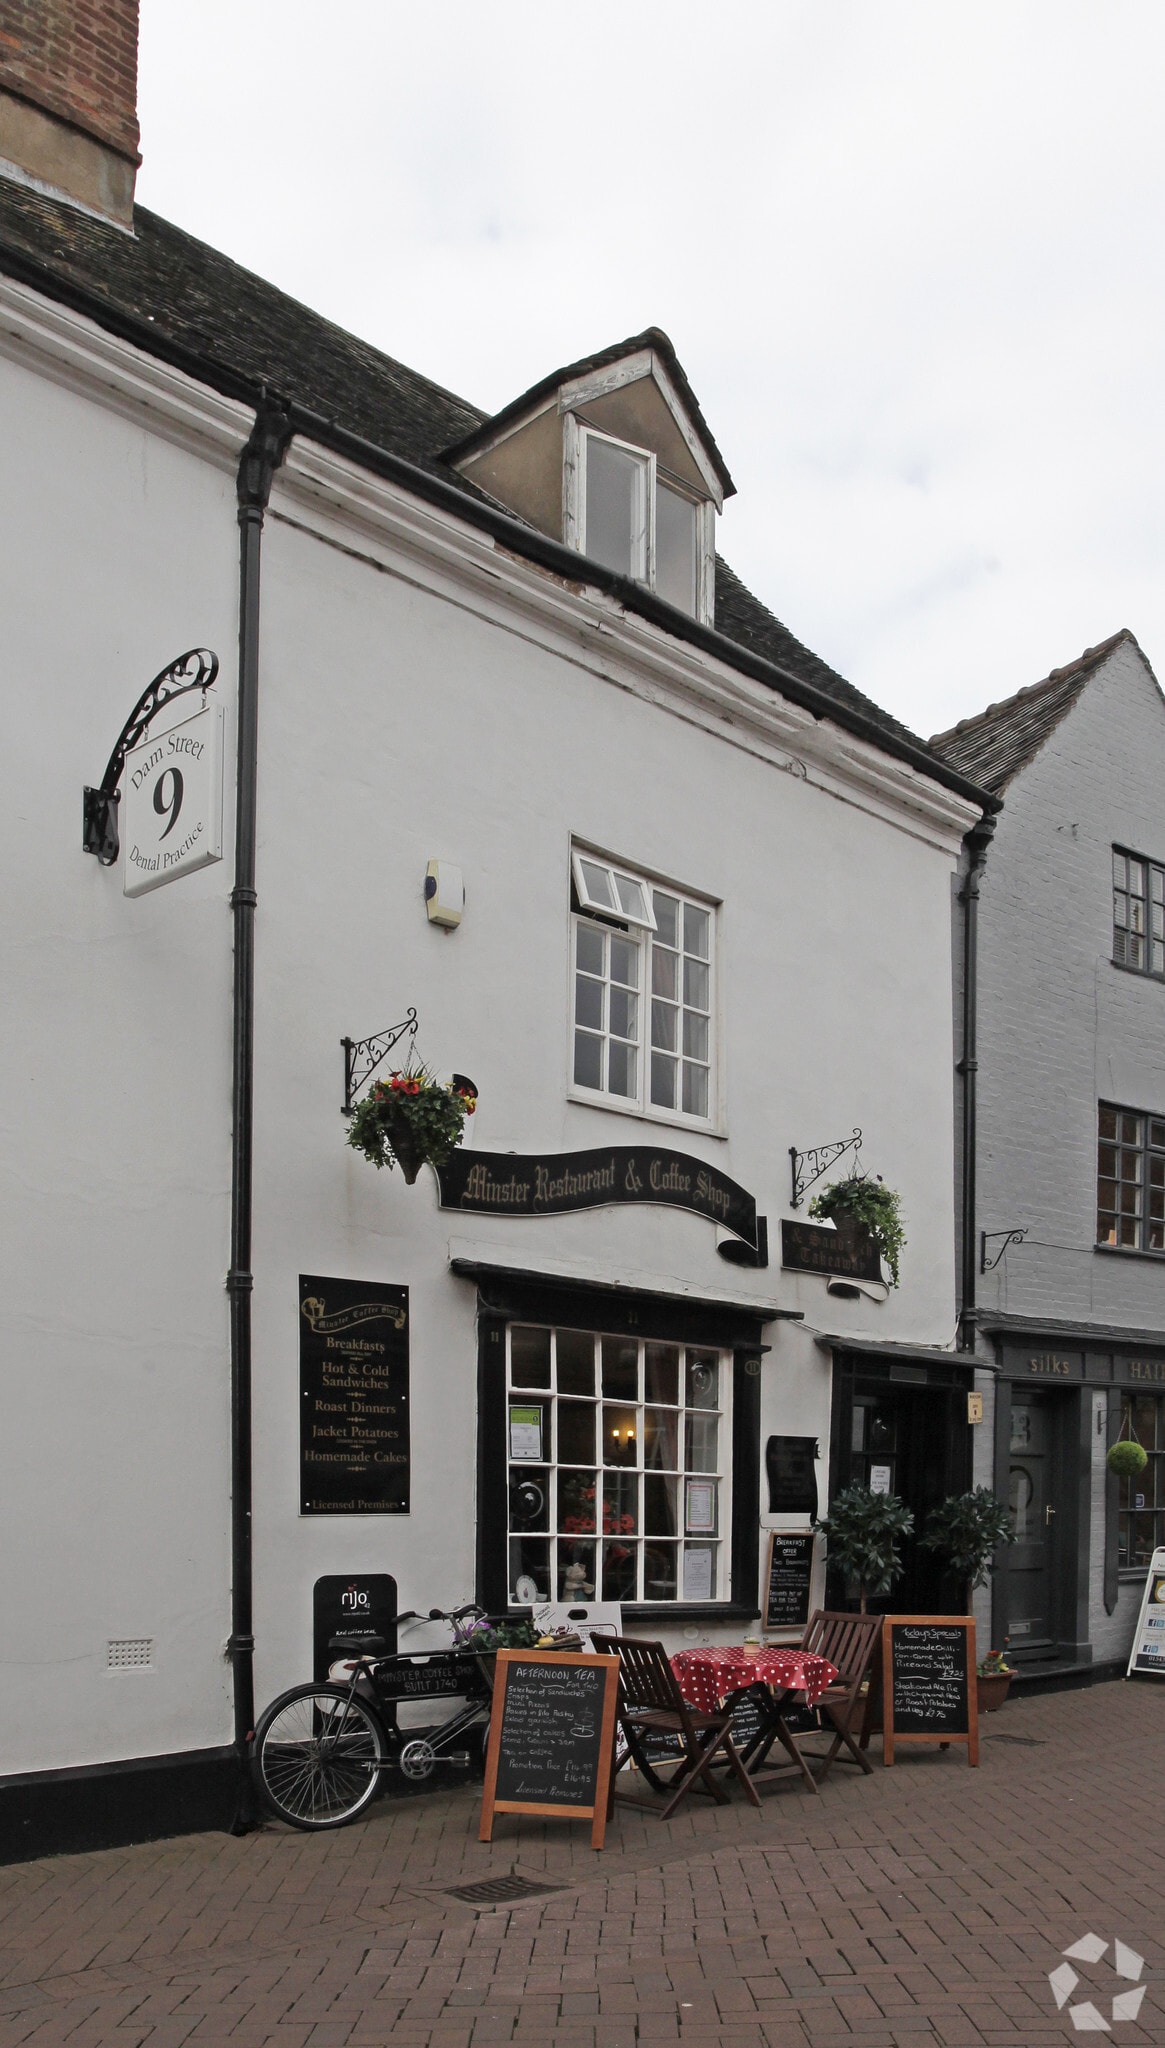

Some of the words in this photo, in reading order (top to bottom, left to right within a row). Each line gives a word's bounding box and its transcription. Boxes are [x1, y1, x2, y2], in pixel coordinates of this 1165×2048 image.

[130, 746, 164, 791] Dam
[166, 733, 206, 761] Street
[152, 767, 184, 842] 9
[129, 844, 161, 871] Dental
[163, 821, 204, 869] Practice
[460, 1164, 530, 1204] Minster
[533, 1158, 616, 1204] Restaurant
[625, 1159, 643, 1192] &
[649, 1160, 690, 1192] Coffee
[693, 1170, 731, 1217] Shop
[809, 1231, 872, 1257] Sandch
[352, 1307, 378, 1318] Coffee
[326, 1337, 386, 1352] Breakfasts
[322, 1361, 344, 1373] Hot
[348, 1363, 359, 1375] &
[362, 1364, 389, 1376] Cold
[1029, 1355, 1070, 1374] silks
[322, 1375, 389, 1389] Sandwiches
[315, 1400, 347, 1412] Roast
[351, 1401, 396, 1414] Dinners
[312, 1425, 347, 1438] Jacket
[351, 1426, 399, 1439] Potatoes
[304, 1450, 370, 1462] Homemade
[374, 1451, 407, 1463] Cakes
[313, 1500, 354, 1509] Licensed
[357, 1499, 399, 1509] Premises
[341, 1586, 368, 1610] rijo
[894, 1642, 935, 1651] Homemade
[932, 1661, 954, 1669] Salad
[515, 1667, 570, 1680] AFTERNOON
[574, 1668, 596, 1681] TEA
[435, 1678, 458, 1691] 1740
[507, 1685, 538, 1694] Selection
[538, 1688, 546, 1697] of
